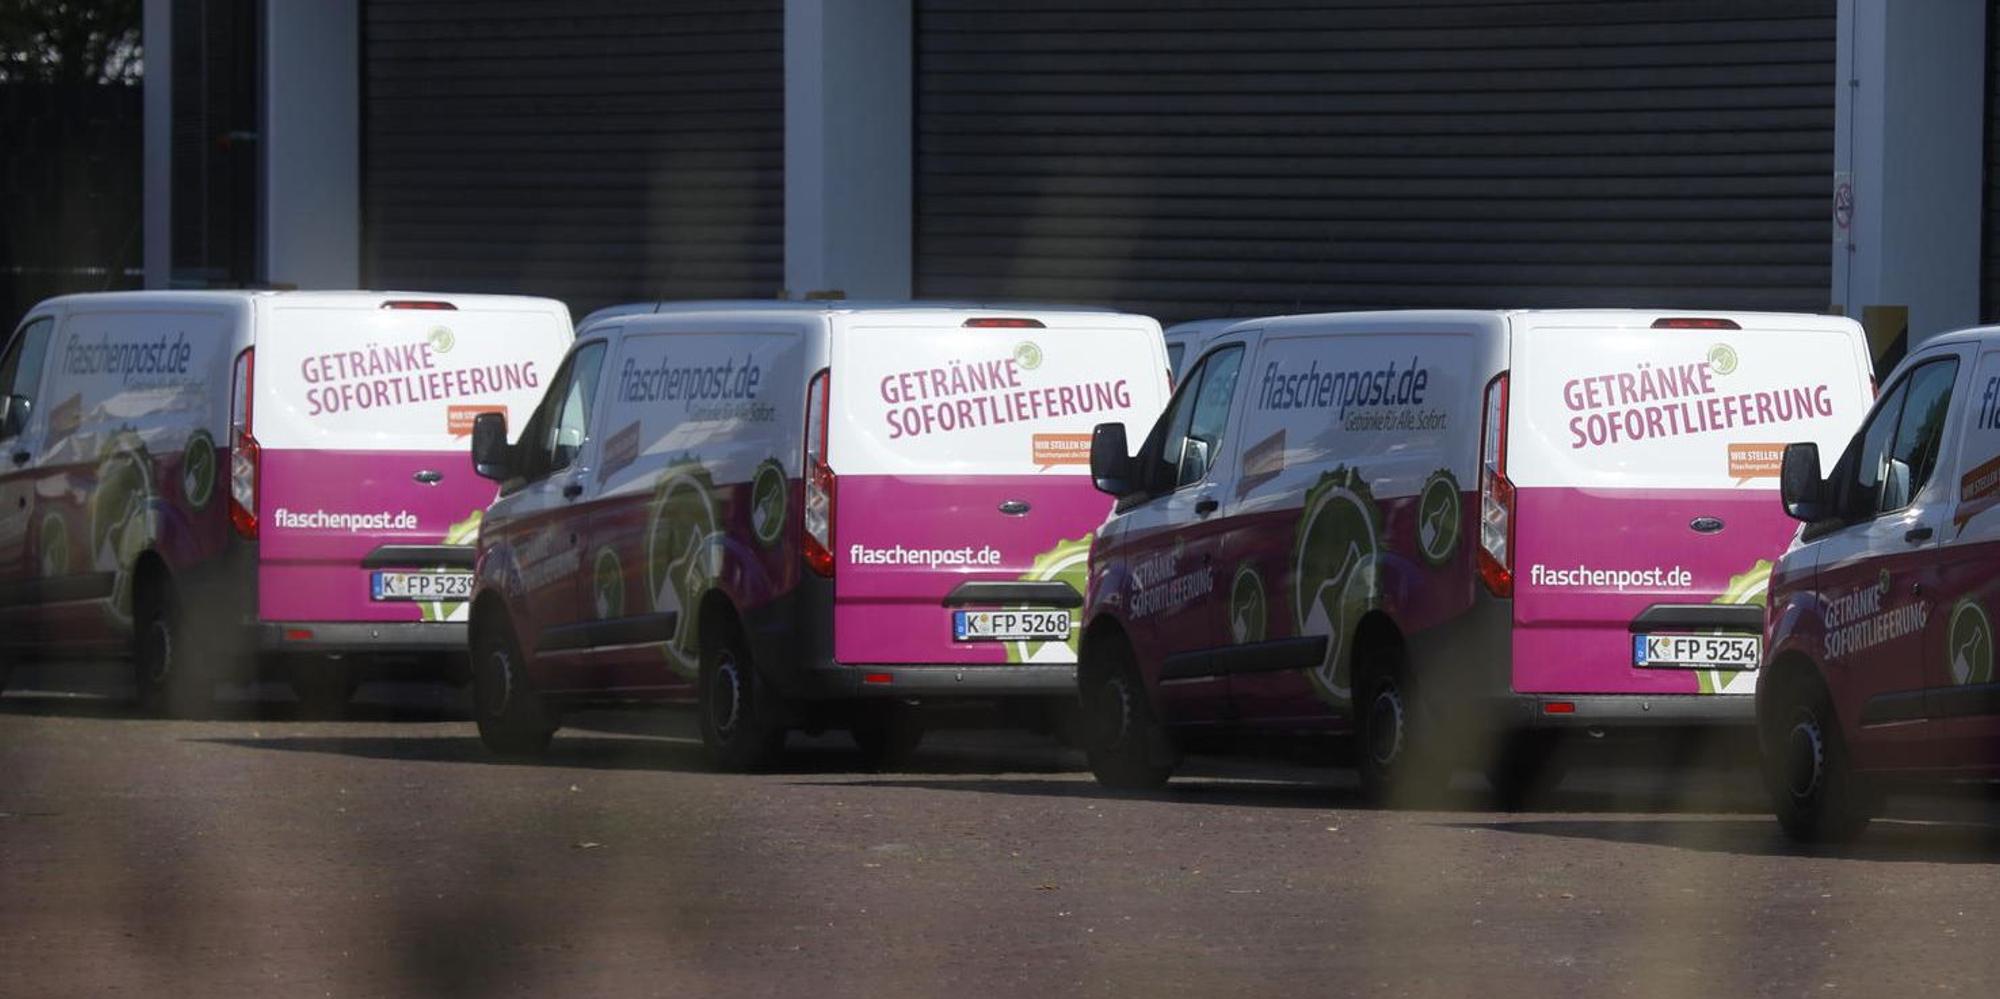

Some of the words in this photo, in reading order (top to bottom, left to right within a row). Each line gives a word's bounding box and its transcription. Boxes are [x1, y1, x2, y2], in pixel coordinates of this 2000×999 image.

[63, 331, 191, 384] flaschenpost.de
[301, 343, 435, 384] GETRÄNKE
[306, 361, 539, 416] SOFORTLIEFERUNG
[617, 353, 760, 412] flaschenpost.de
[880, 358, 1022, 404] GETRÄNKE
[1258, 355, 1428, 421] flaschenpost.de
[1563, 363, 1715, 411] GETRÄNKE
[886, 379, 1131, 439] SOFORTLIEFERUNG
[1569, 385, 1833, 449] SOFORTLIEFERUNG
[1745, 451, 1779, 461] STELLEN
[275, 508, 417, 532] flaschenpost.de
[850, 544, 1001, 569] flaschenpost.de
[1531, 564, 1692, 590] flaschenpost.de
[384, 575, 395, 593] K
[407, 576, 430, 594] FP
[1825, 585, 1881, 629] GETRÄNKE
[967, 615, 979, 633] K
[992, 615, 1017, 633] FP
[1022, 614, 1067, 633] 5268
[1824, 600, 1927, 660] SOFORTLIEFERUNG
[1648, 639, 1660, 659] K
[1675, 640, 1700, 660] FP
[1706, 639, 1755, 661] 5254
